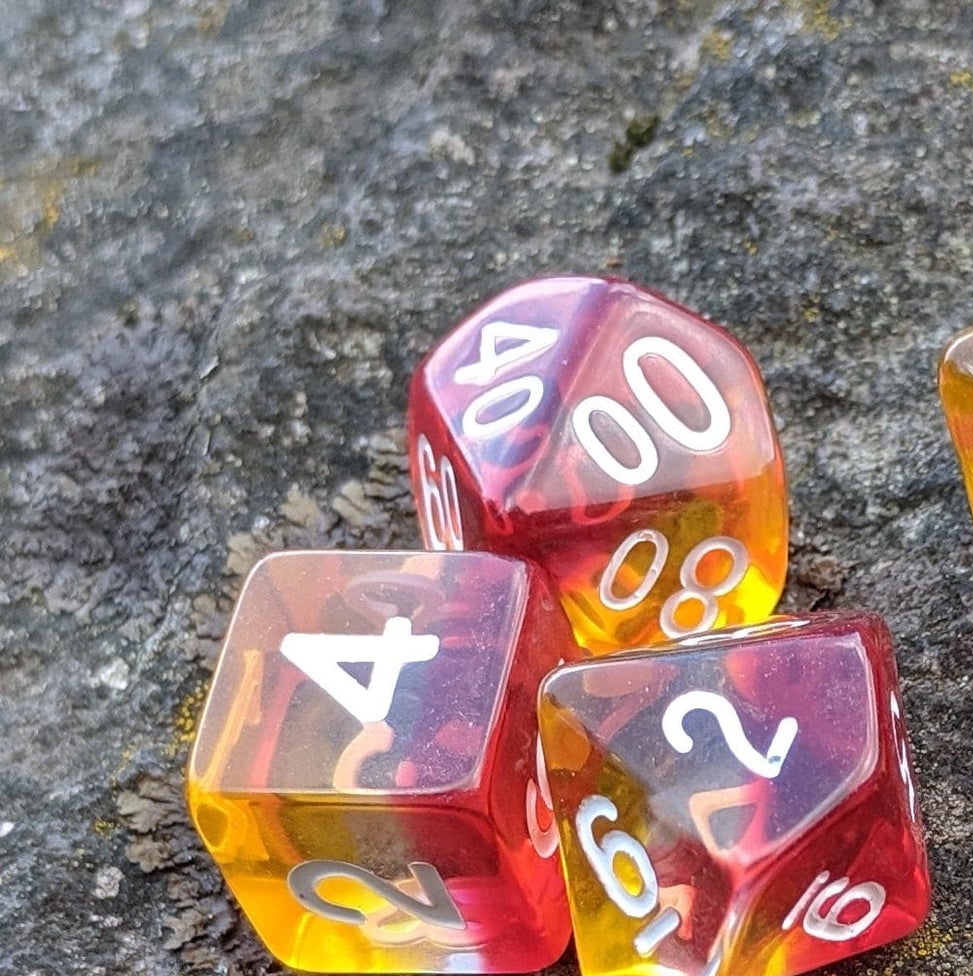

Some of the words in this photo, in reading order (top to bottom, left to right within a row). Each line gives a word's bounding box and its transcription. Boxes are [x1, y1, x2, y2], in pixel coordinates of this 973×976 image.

[454, 321, 560, 440] 40
[573, 336, 731, 486] 00
[599, 529, 748, 640] 80
[280, 616, 440, 723] 4
[662, 691, 798, 778] 2
[287, 859, 467, 929] 2
